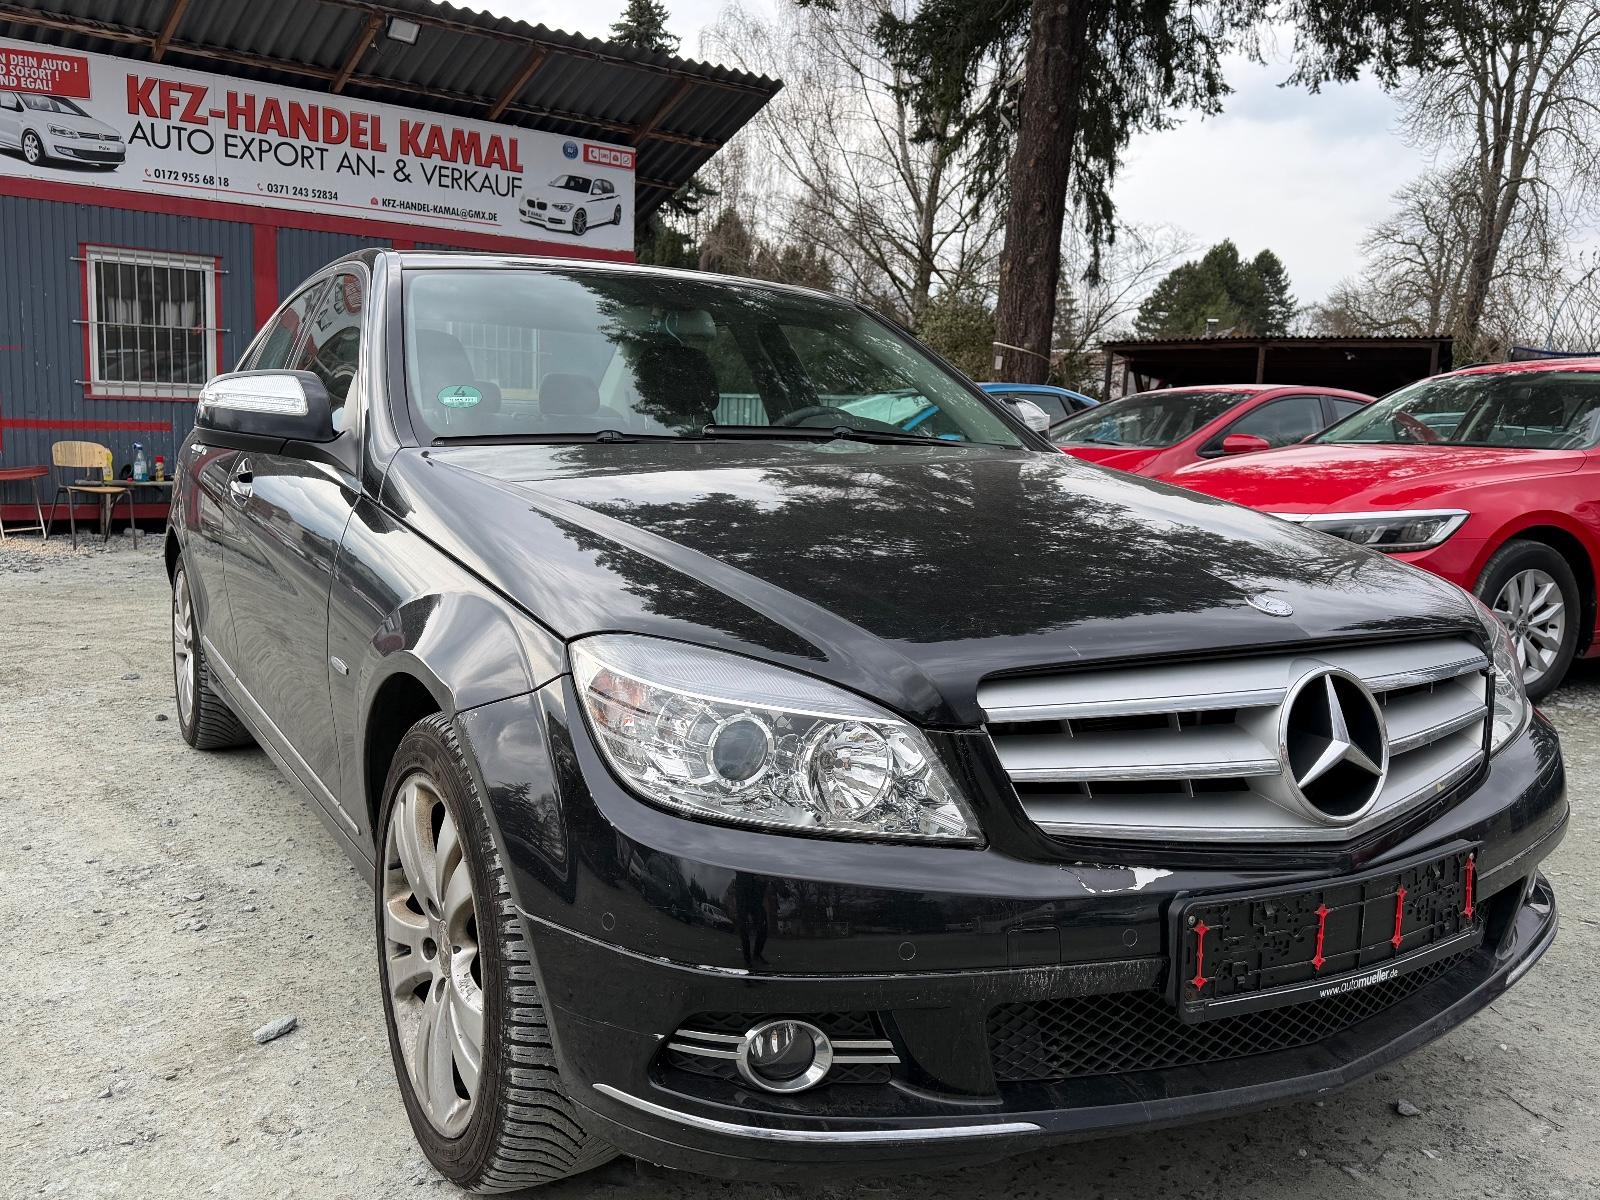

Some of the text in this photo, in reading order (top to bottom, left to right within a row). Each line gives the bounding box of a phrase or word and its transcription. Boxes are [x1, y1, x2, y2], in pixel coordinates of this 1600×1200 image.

[10, 54, 37, 68] DEIN
[41, 58, 70, 72] AUTO
[10, 65, 52, 81] SOFORT
[21, 77, 52, 91] EGAL!
[127, 73, 524, 174] KFZ-HANDEL KAMAL
[128, 120, 523, 198] AUTO EXPORT AN- & VERKAUF
[154, 168, 230, 188] 0172 955 68 18
[267, 183, 338, 201] 0371 243 52834
[382, 198, 498, 222] KFZ-HANDEL-KAMAL@GMX.DE
[1319, 968, 1399, 998] www.automueller.de
